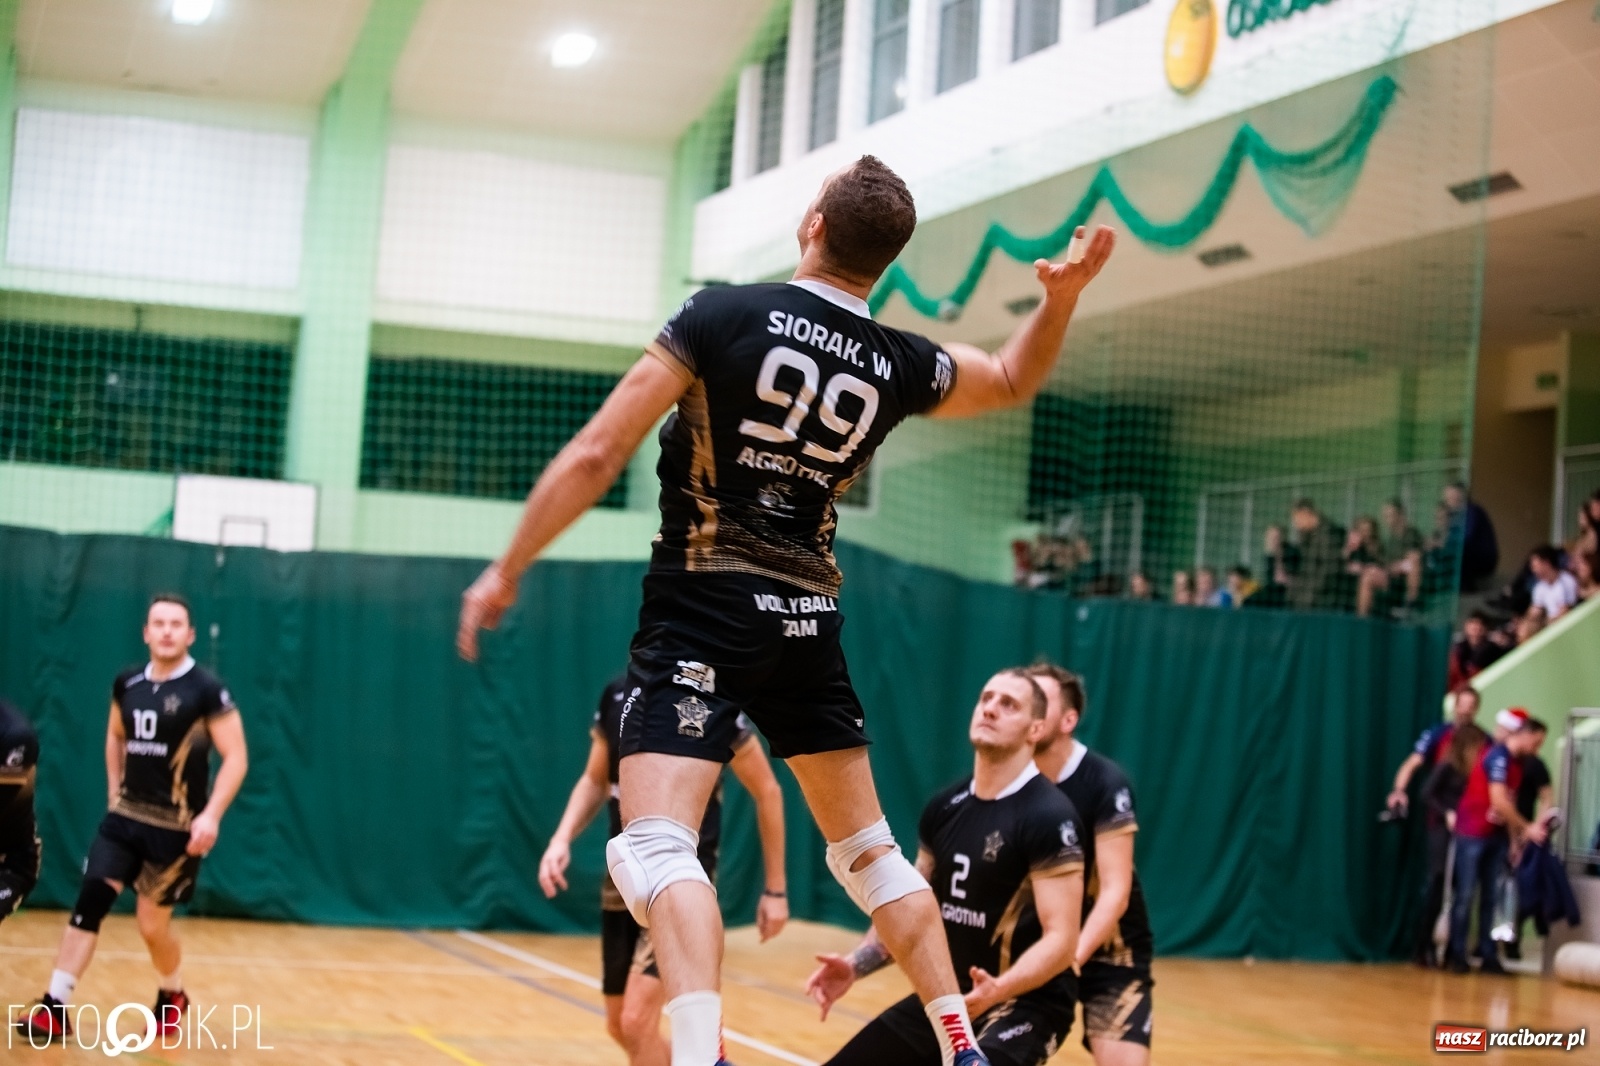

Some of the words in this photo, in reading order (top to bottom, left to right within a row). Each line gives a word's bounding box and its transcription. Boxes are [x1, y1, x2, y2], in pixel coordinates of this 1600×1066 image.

[766, 310, 865, 368] SIORAK.
[872, 351, 892, 381] W
[737, 345, 880, 464] 99
[132, 708, 158, 740] 10
[950, 852, 971, 899] 2
[942, 902, 986, 929] GROTIM
